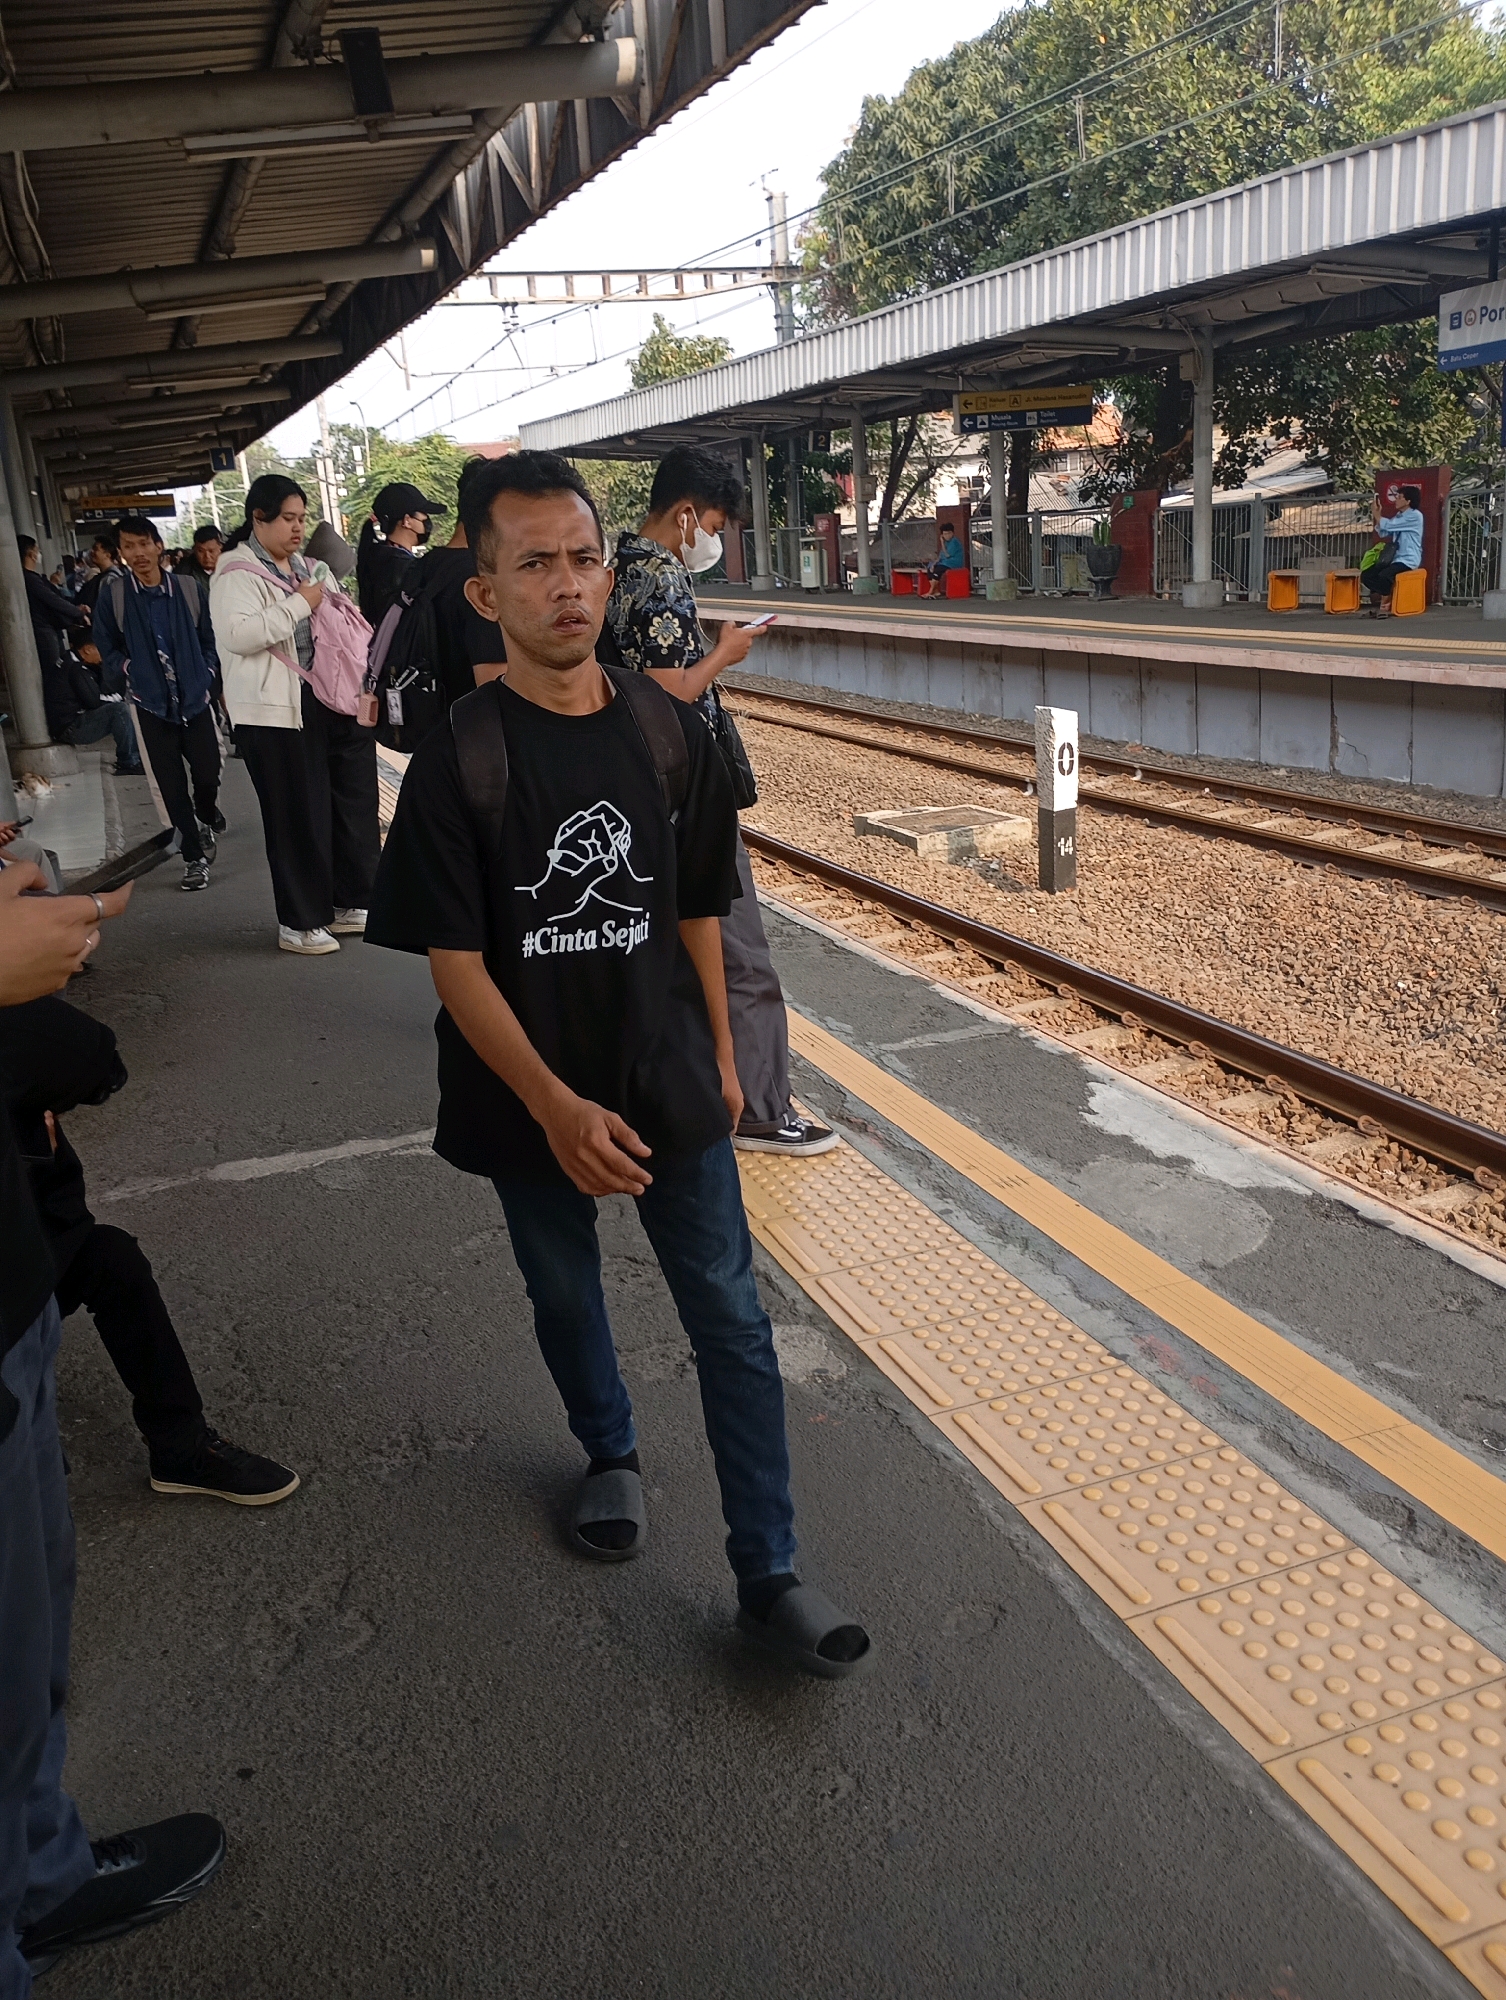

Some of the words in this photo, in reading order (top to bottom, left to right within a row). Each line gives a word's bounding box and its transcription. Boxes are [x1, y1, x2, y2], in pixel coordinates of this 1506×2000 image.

[1480, 305, 1506, 325] Por
[1450, 355, 1462, 363] Batu
[1462, 352, 1479, 360] Ceper
[1011, 396, 1019, 405] A
[991, 413, 1012, 421] Musala
[818, 435, 825, 447] 2
[218, 452, 227, 466] 1
[1058, 742, 1074, 776] 0
[1057, 836, 1074, 857] 14
[522, 926, 597, 958] #Cinta
[601, 911, 650, 955] Sejati
